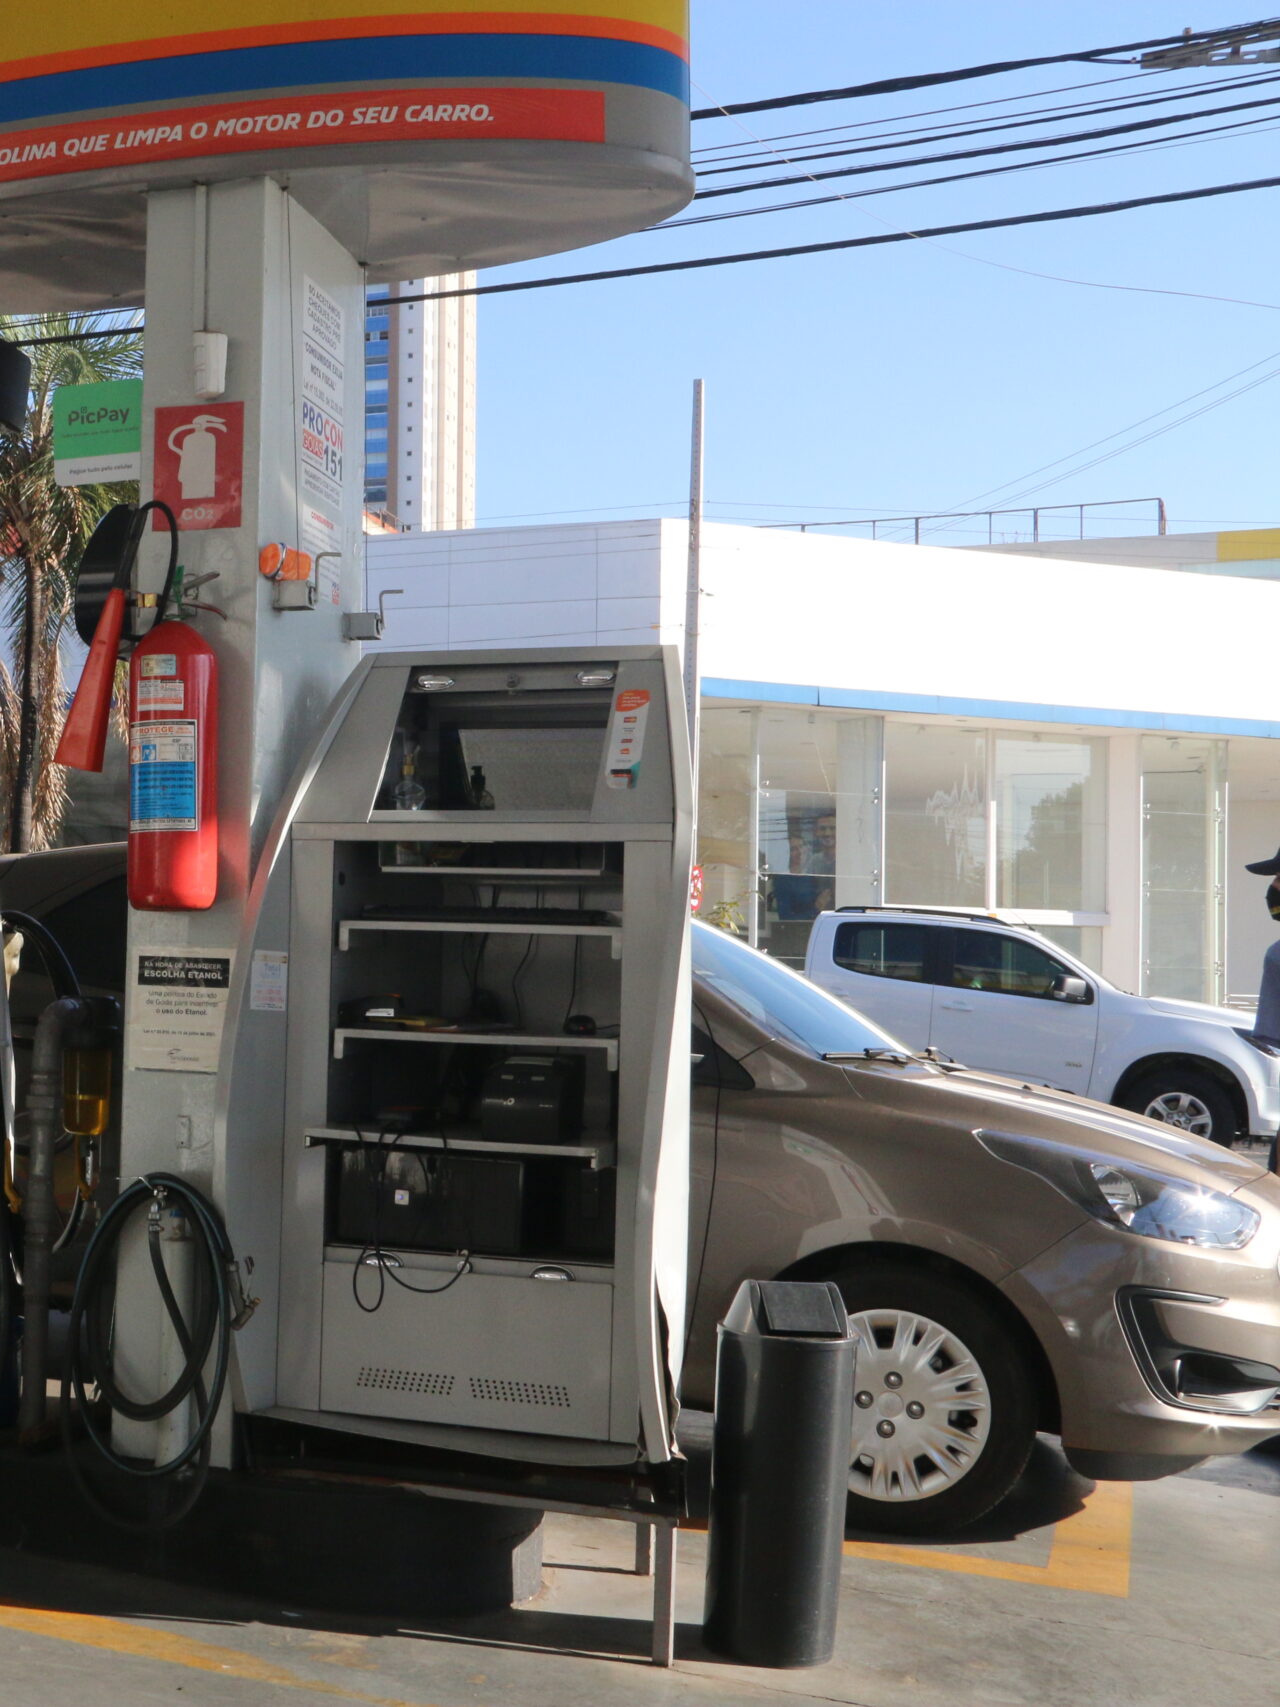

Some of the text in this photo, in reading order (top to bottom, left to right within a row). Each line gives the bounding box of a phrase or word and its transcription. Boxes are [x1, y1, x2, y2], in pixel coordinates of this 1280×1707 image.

[63, 134, 110, 157] QUE
[115, 124, 182, 149] LIMPA
[190, 122, 208, 140] O
[213, 112, 302, 138] MOTOR
[306, 109, 344, 129] DO
[349, 105, 400, 125] SEU
[404, 103, 495, 123] CARRO.
[67, 406, 130, 426] PicPay
[302, 401, 343, 453] PROCON
[323, 445, 343, 482] 151
[144, 970, 223, 979] ESCOLHA ETANOL
